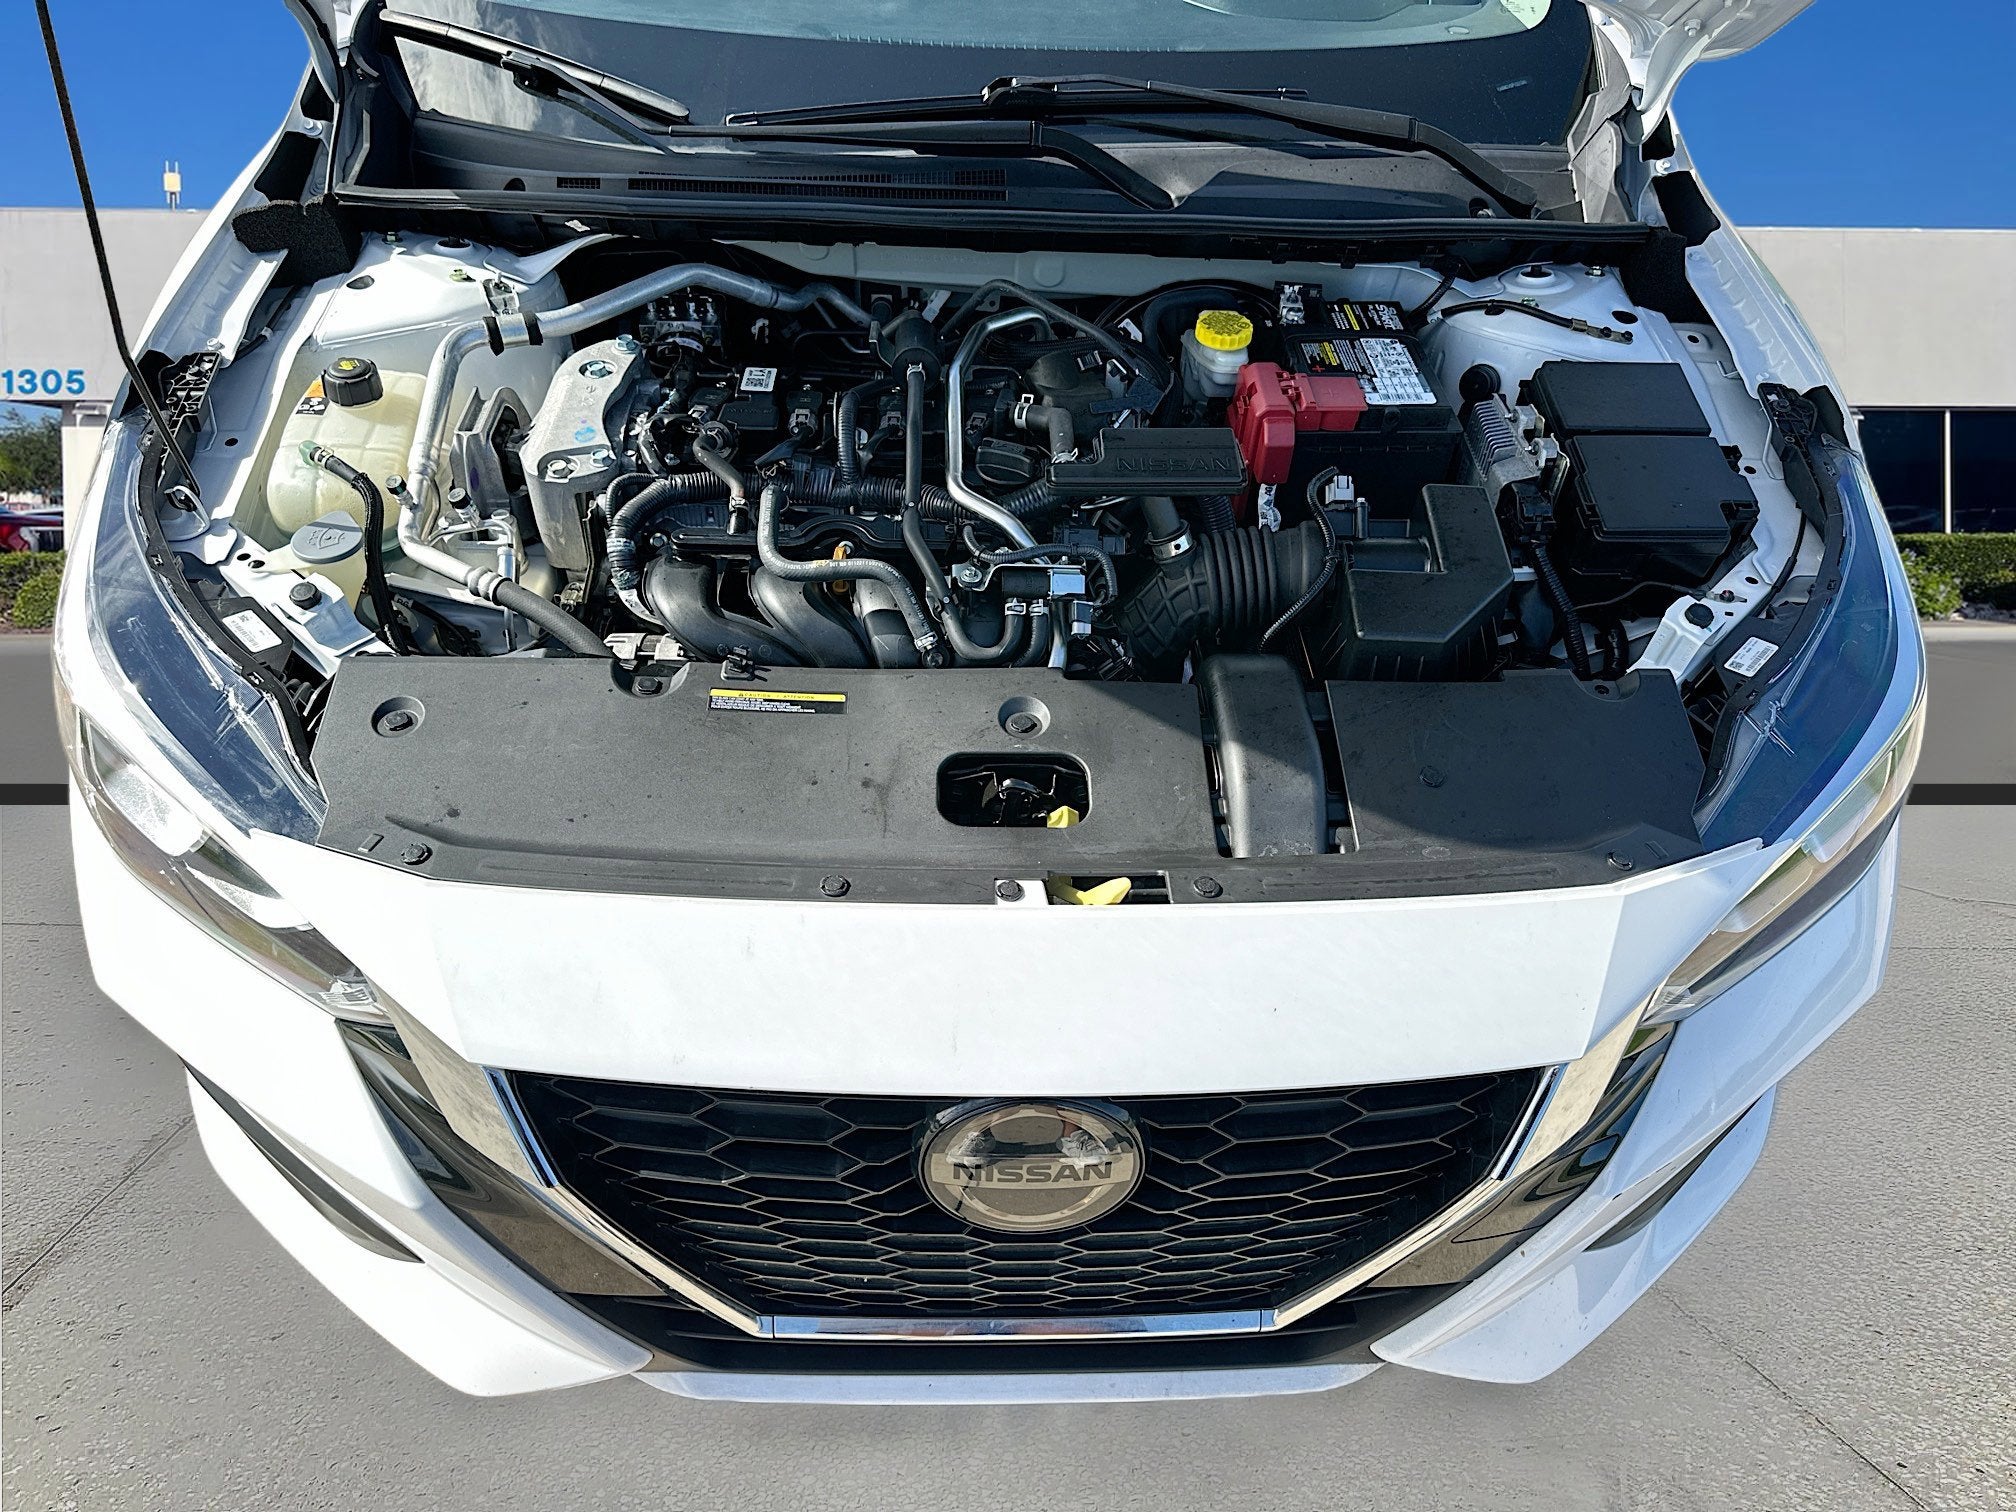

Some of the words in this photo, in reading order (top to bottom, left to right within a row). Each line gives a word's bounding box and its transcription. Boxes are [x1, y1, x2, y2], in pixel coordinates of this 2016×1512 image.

[2, 369, 85, 394] 1305
[1117, 457, 1233, 471] NISSAN
[953, 1161, 1113, 1183] NISSAN
